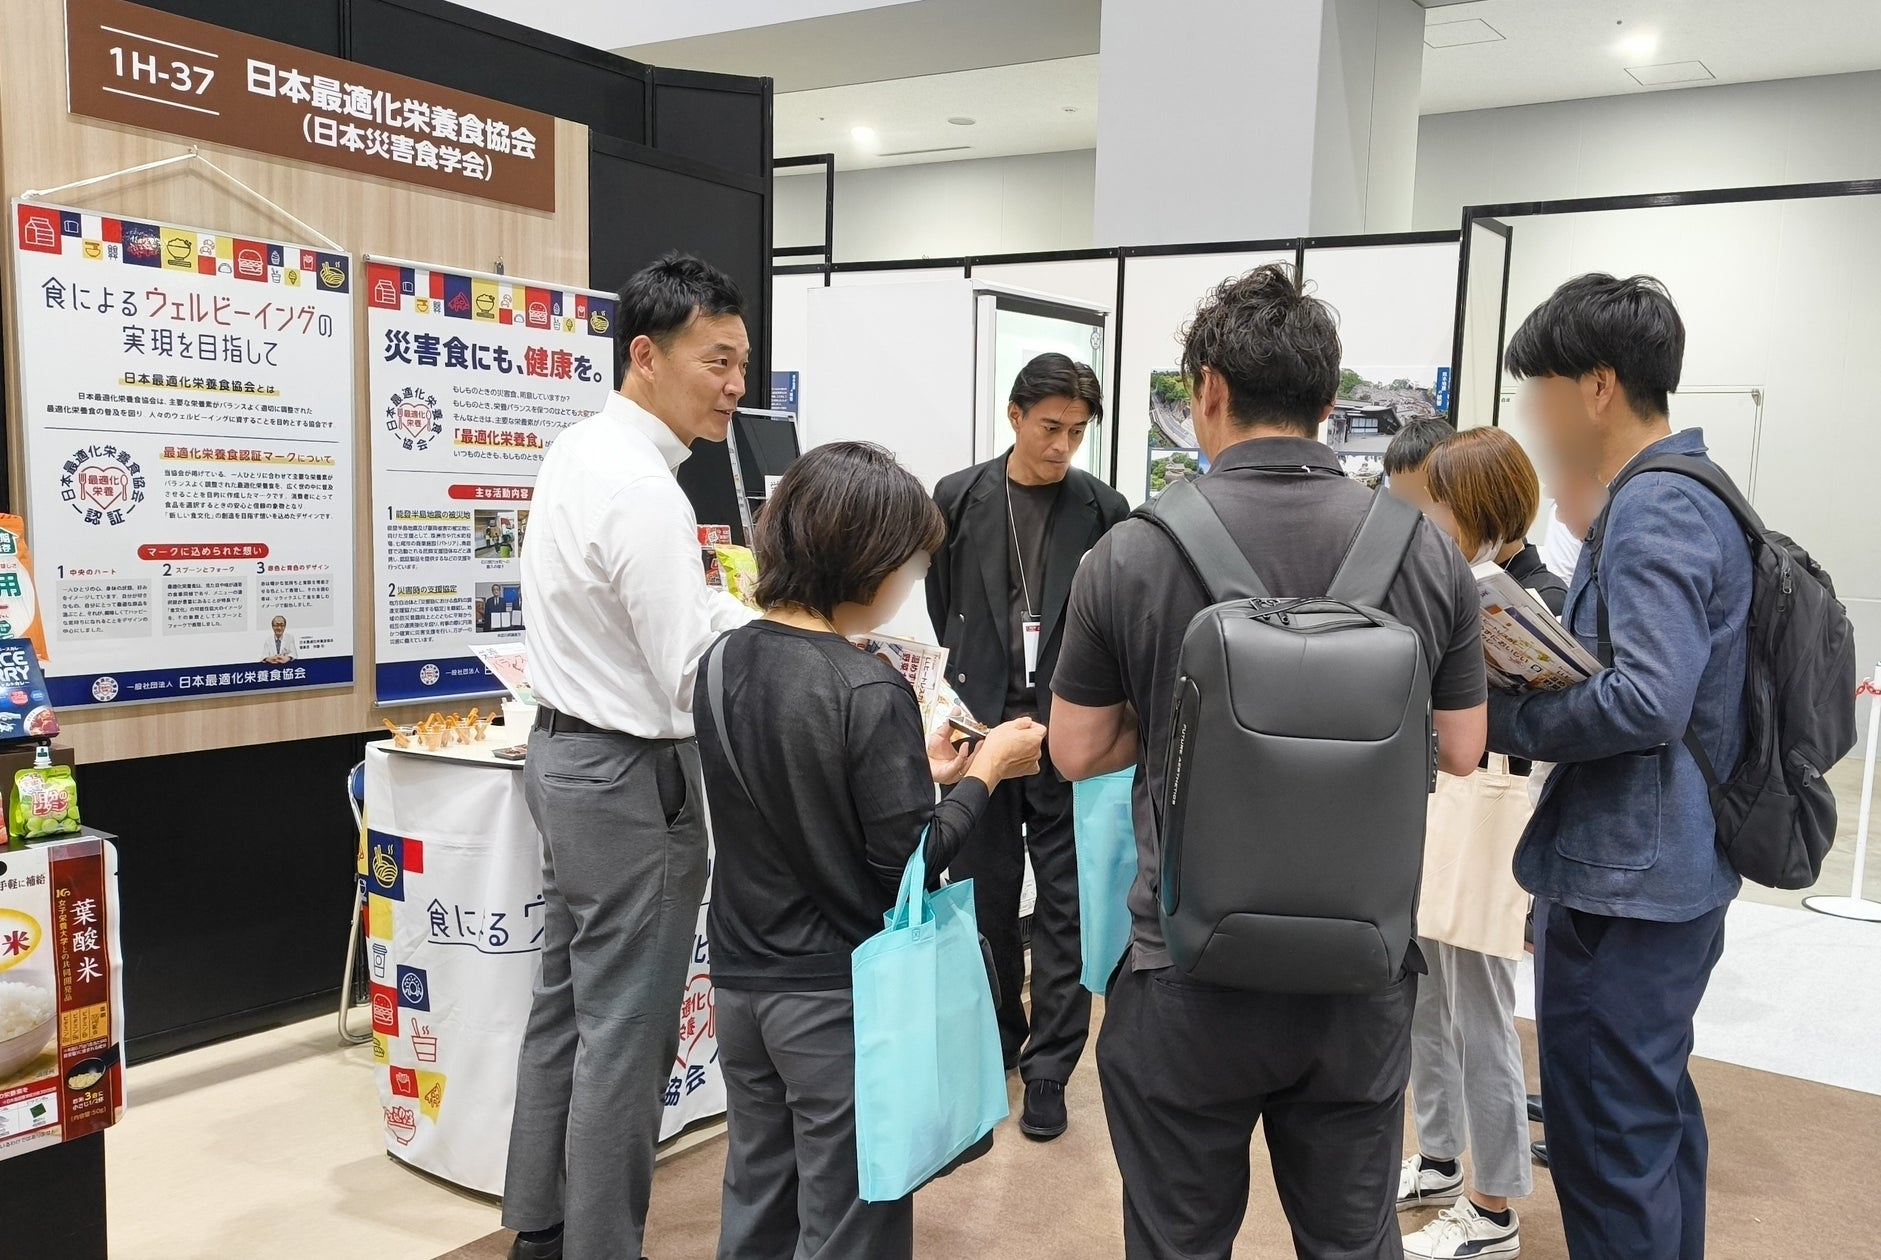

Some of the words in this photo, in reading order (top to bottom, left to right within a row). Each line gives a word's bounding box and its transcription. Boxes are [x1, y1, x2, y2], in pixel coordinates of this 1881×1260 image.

[110, 47, 215, 95] 1H-37
[247, 58, 537, 159] 日本最適化栄養食協会
[302, 113, 493, 181] （日本災害食学会）
[41, 276, 333, 338] 食によるウェルビーイングの
[122, 325, 278, 366] 実現を目指して
[384, 329, 602, 383] 災害食にも、健康を。
[124, 372, 275, 394] 日本最適化栄養食協会とは
[453, 413, 577, 429] そんなときは、主要な栄養素がバランスよく
[164, 446, 332, 464] 最適化栄養食認証マークについて
[88, 475, 119, 485] 最適化
[93, 487, 113, 496] 栄養
[475, 487, 529, 499] 主な活動内容
[84, 508, 125, 526] 認証
[387, 506, 393, 520] 1
[148, 546, 262, 557] マークに込められた想い
[57, 565, 64, 579] 1
[163, 563, 172, 577] 2
[256, 561, 265, 574] 3
[388, 583, 396, 597] 2
[0, 651, 28, 667] CE
[179, 667, 306, 689] 日本最適化栄養食協会
[1, 930, 31, 956] 米
[69, 898, 103, 984] 葉酸米
